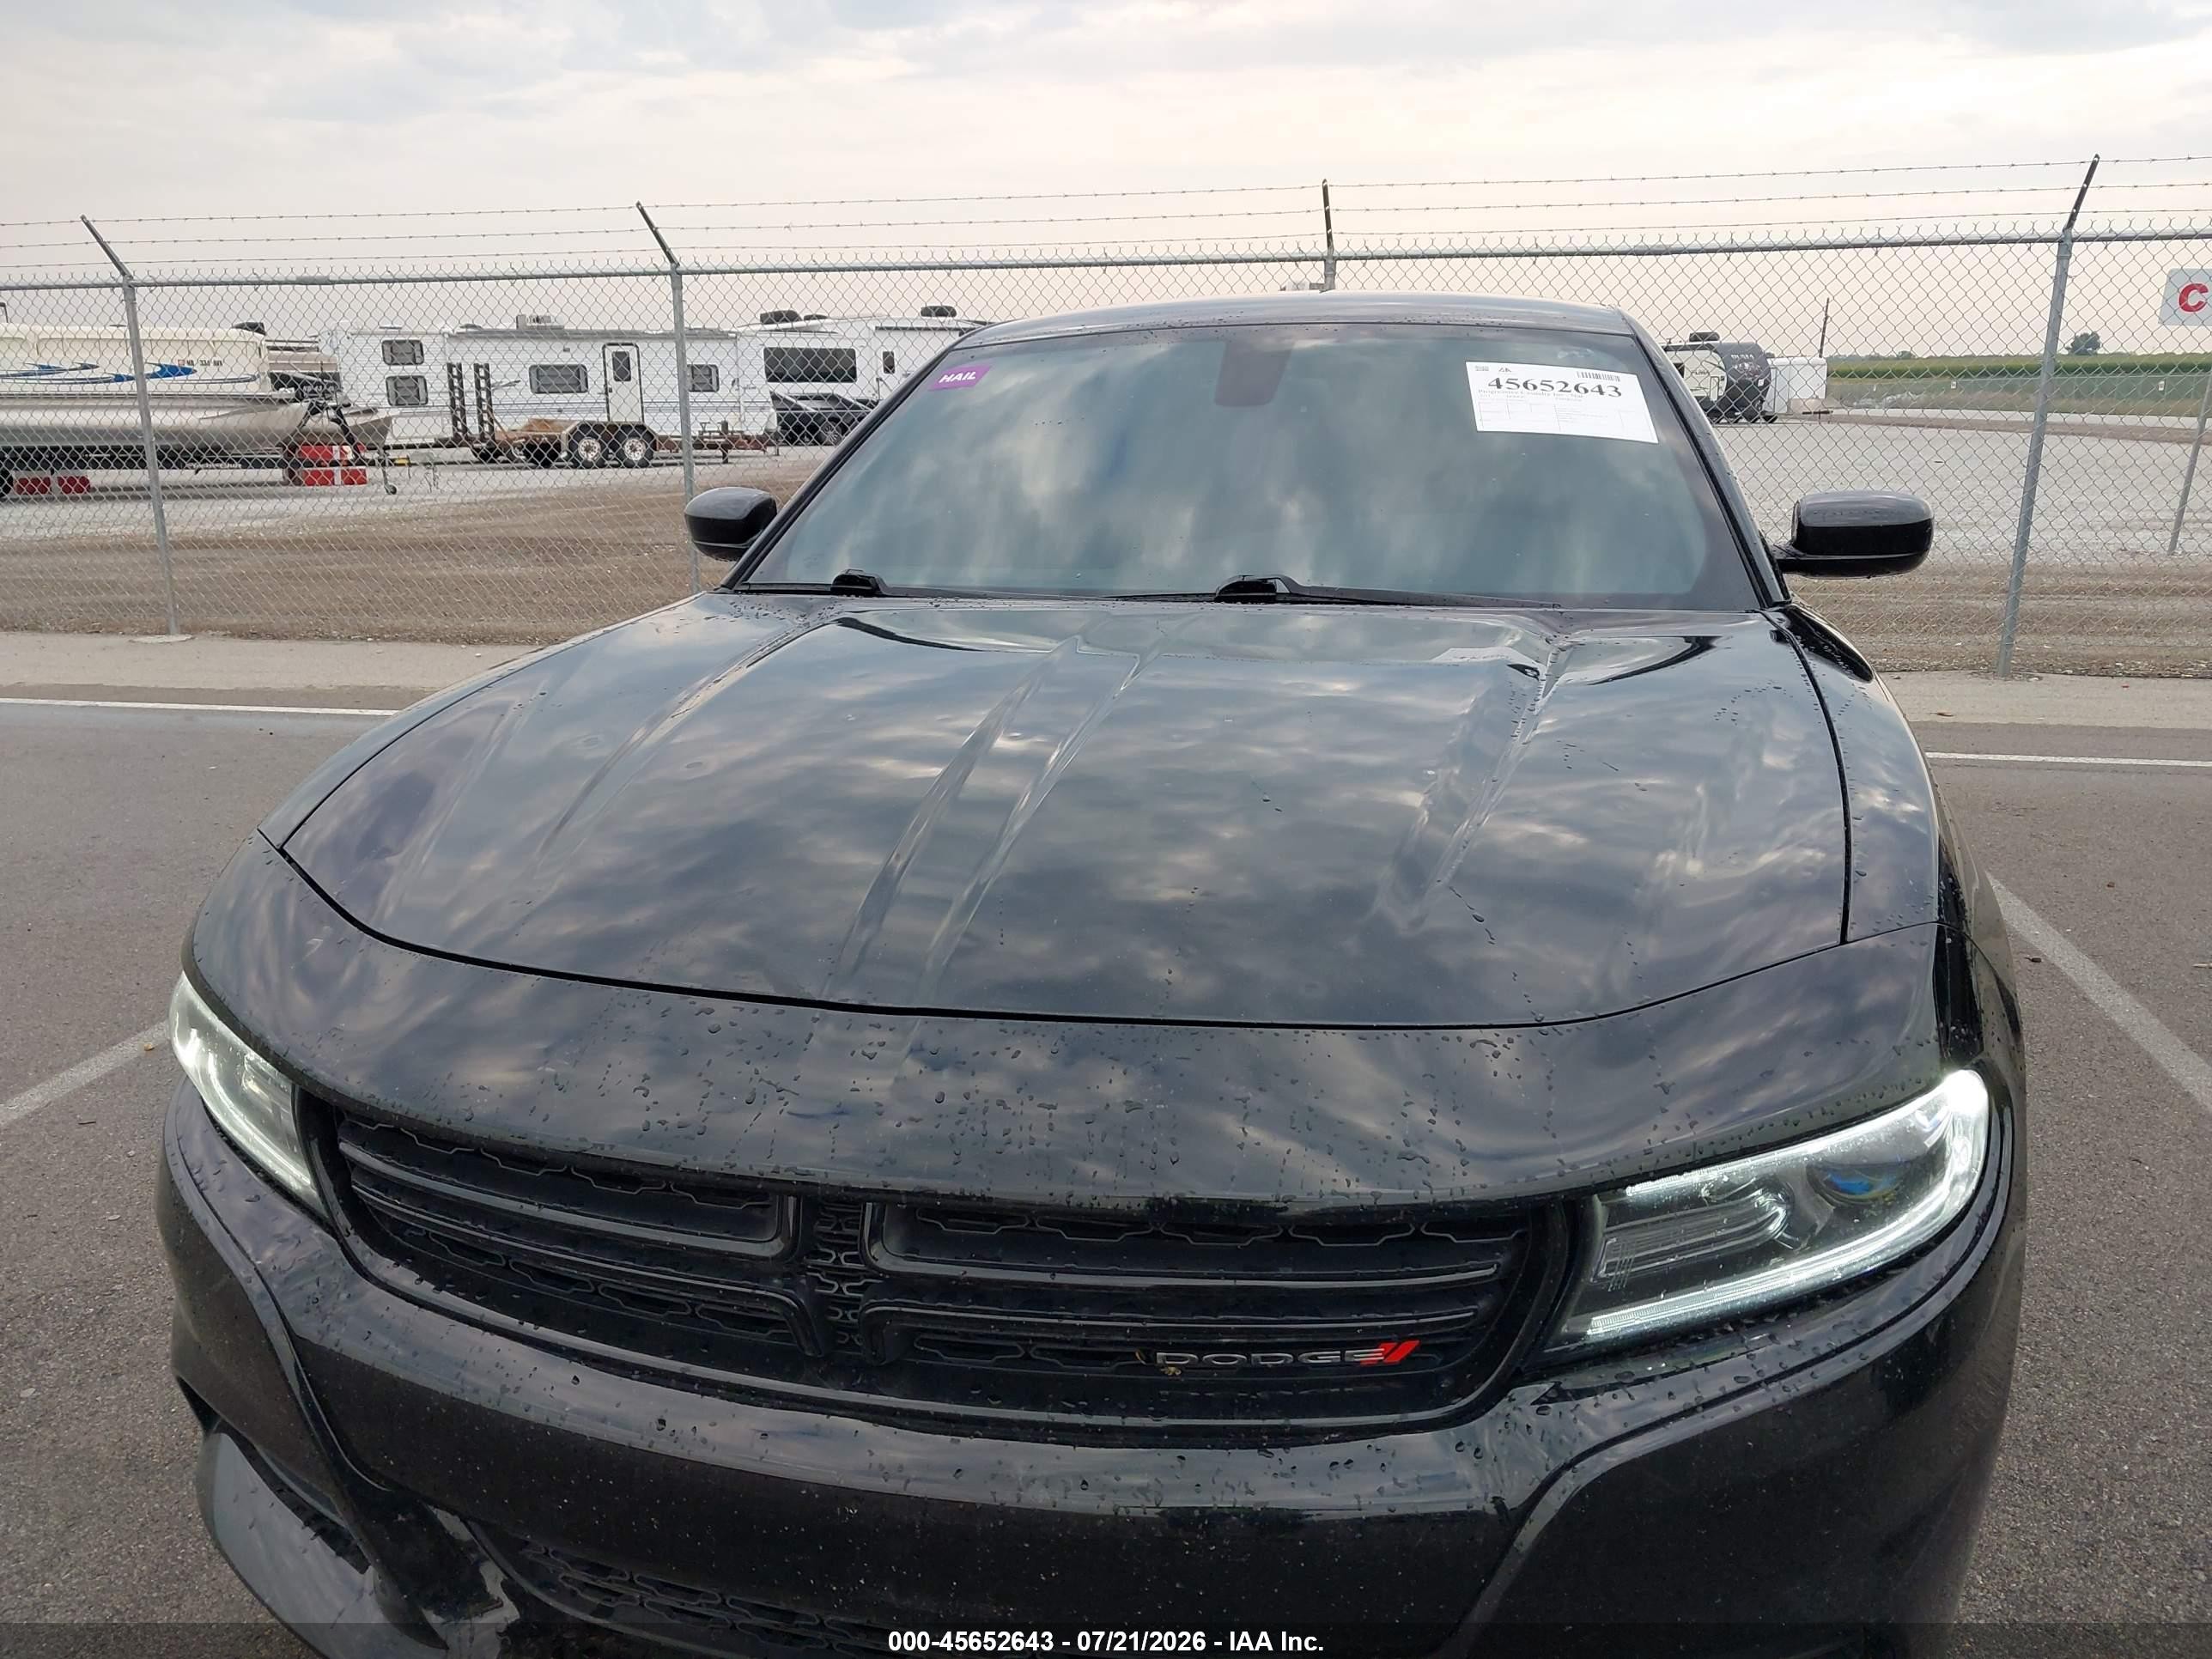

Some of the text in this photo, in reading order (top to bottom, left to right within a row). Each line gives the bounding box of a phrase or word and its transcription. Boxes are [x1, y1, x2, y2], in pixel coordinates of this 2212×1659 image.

[2179, 283, 2209, 313] C
[939, 371, 976, 383] HAIL
[1488, 377, 1623, 398] 45652643
[1156, 1347, 1384, 1366] DODGE
